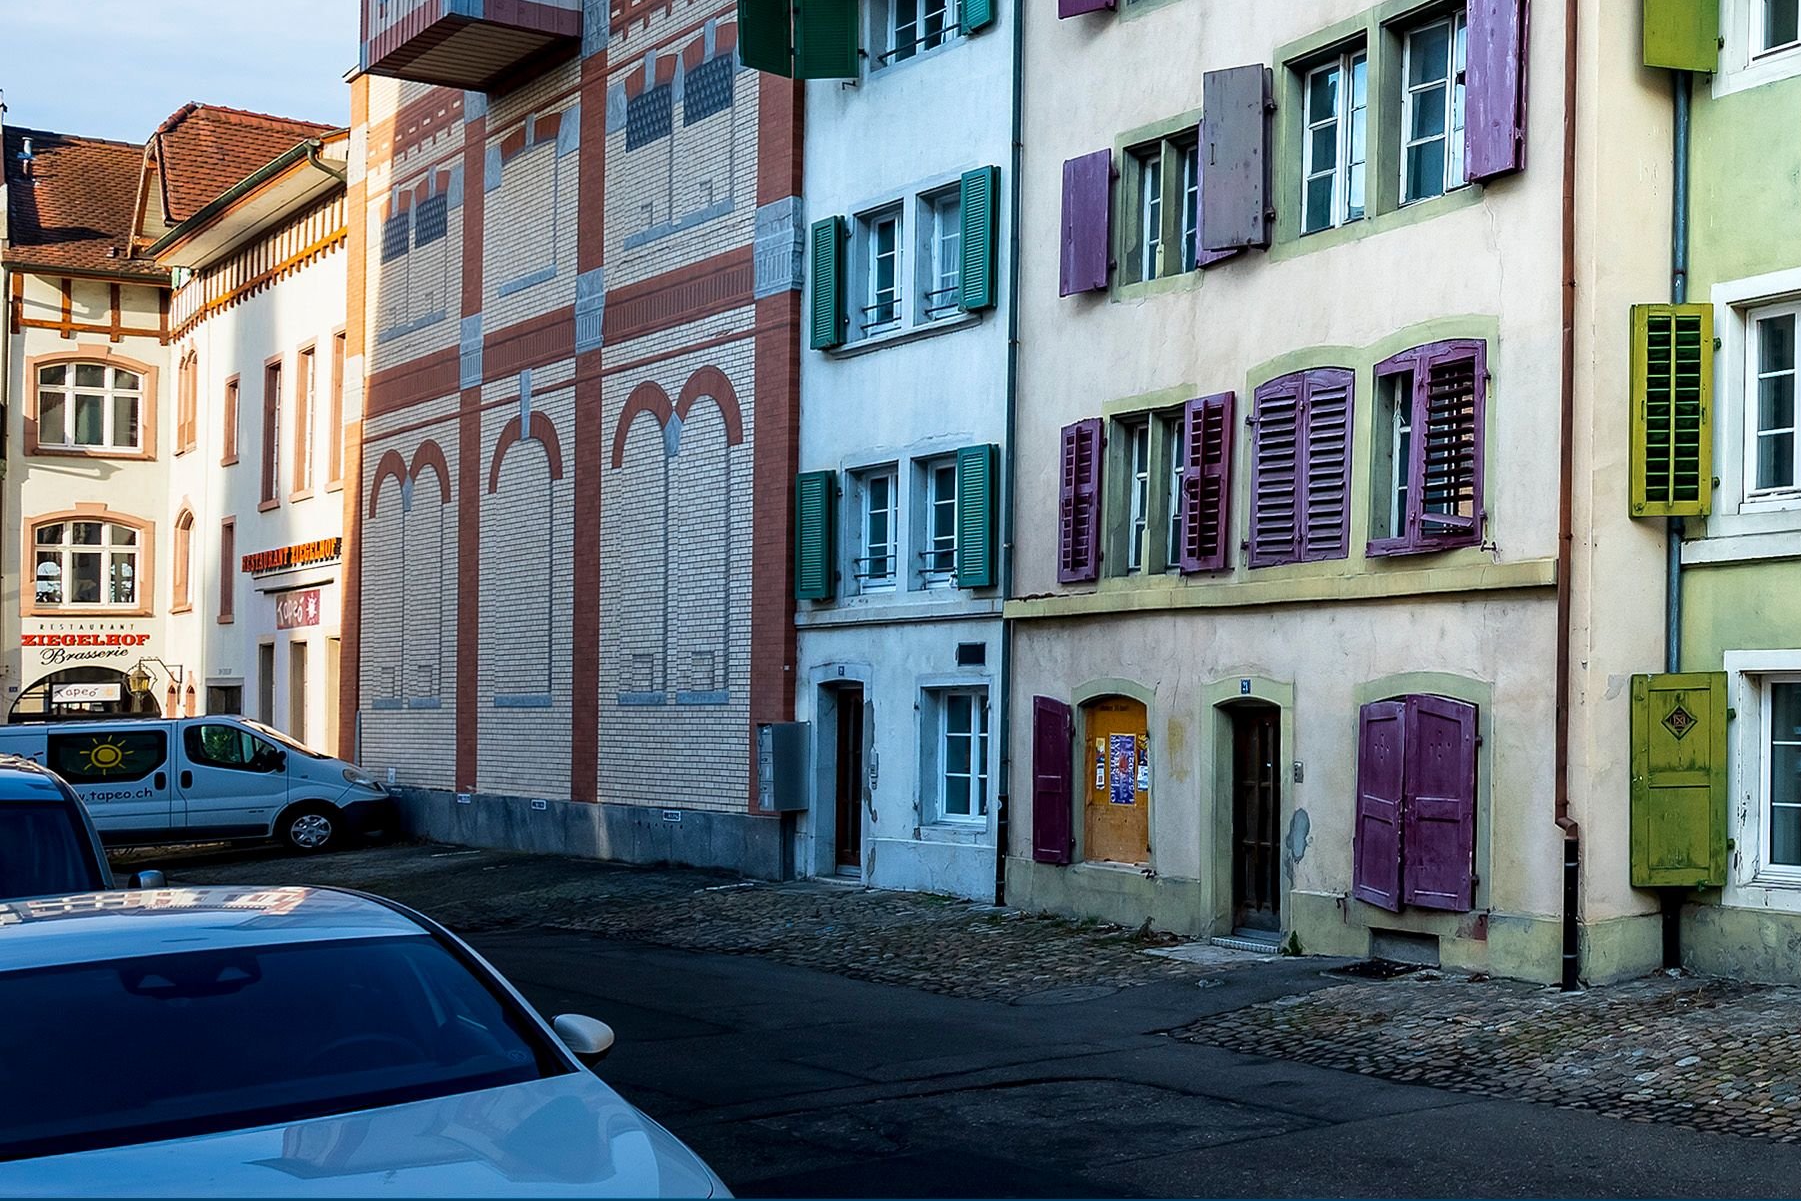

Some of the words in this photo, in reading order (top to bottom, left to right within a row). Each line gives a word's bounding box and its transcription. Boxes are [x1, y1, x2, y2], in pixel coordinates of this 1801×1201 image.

[242, 547, 289, 573] RESTAURANT
[291, 537, 339, 564] ZIEGELHOF
[40, 623, 135, 631] RESTAURANT
[21, 634, 151, 647] ZIEGELHOF
[39, 646, 129, 666] Brasserie
